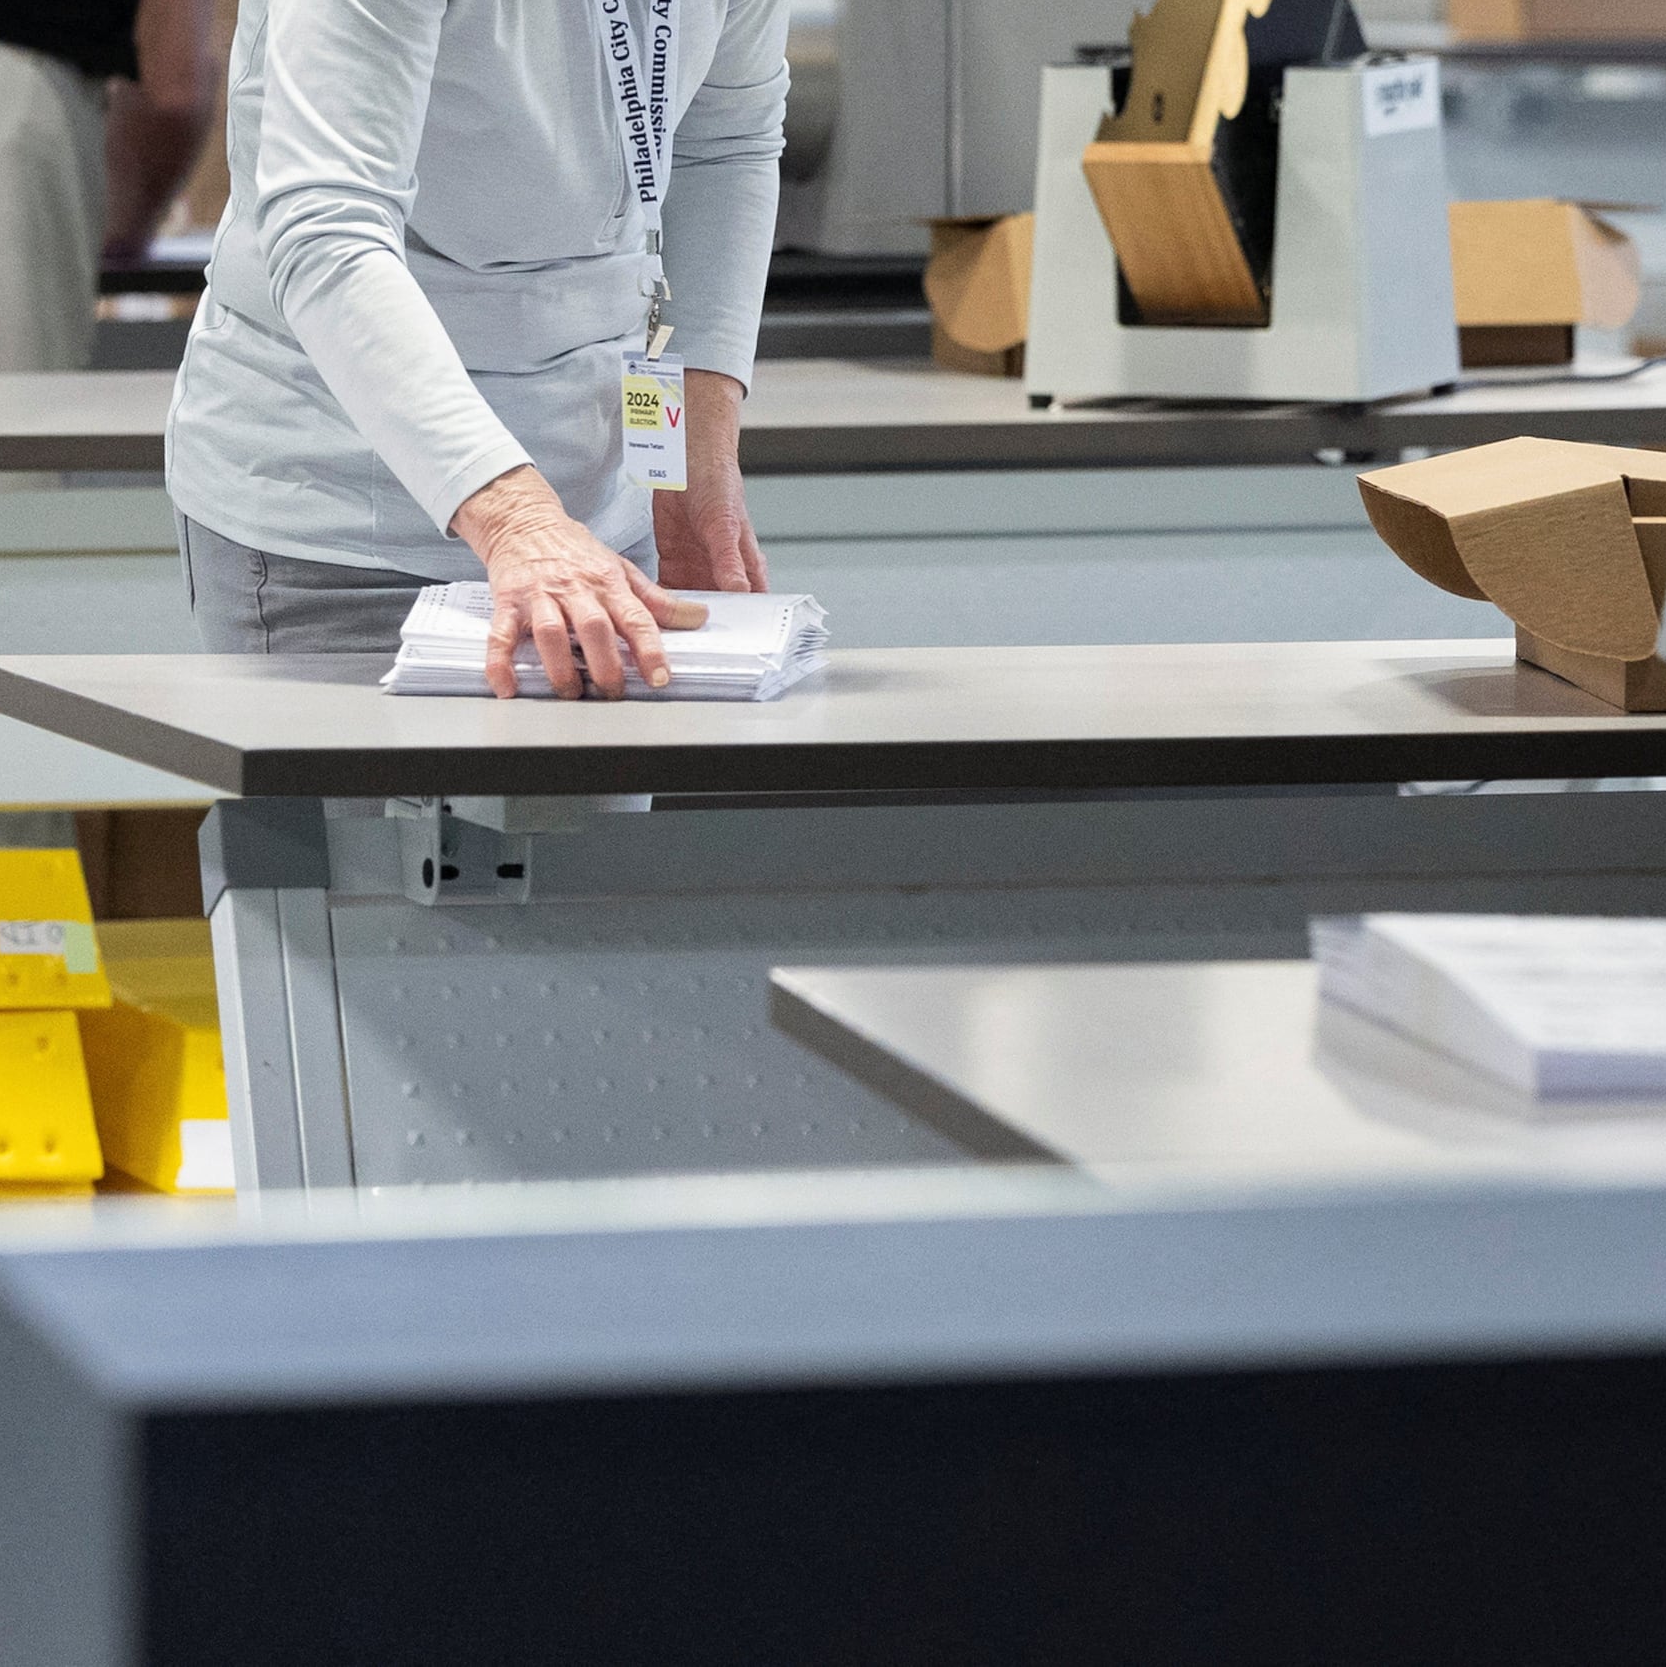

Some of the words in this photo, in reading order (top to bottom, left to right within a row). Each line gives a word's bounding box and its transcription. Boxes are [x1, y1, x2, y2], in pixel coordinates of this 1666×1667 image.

[609, 19, 630, 61] City
[617, 64, 658, 204] Philadelphia
[626, 392, 660, 408] 2024
[629, 418, 658, 426] ELECTION
[665, 406, 681, 428] V
